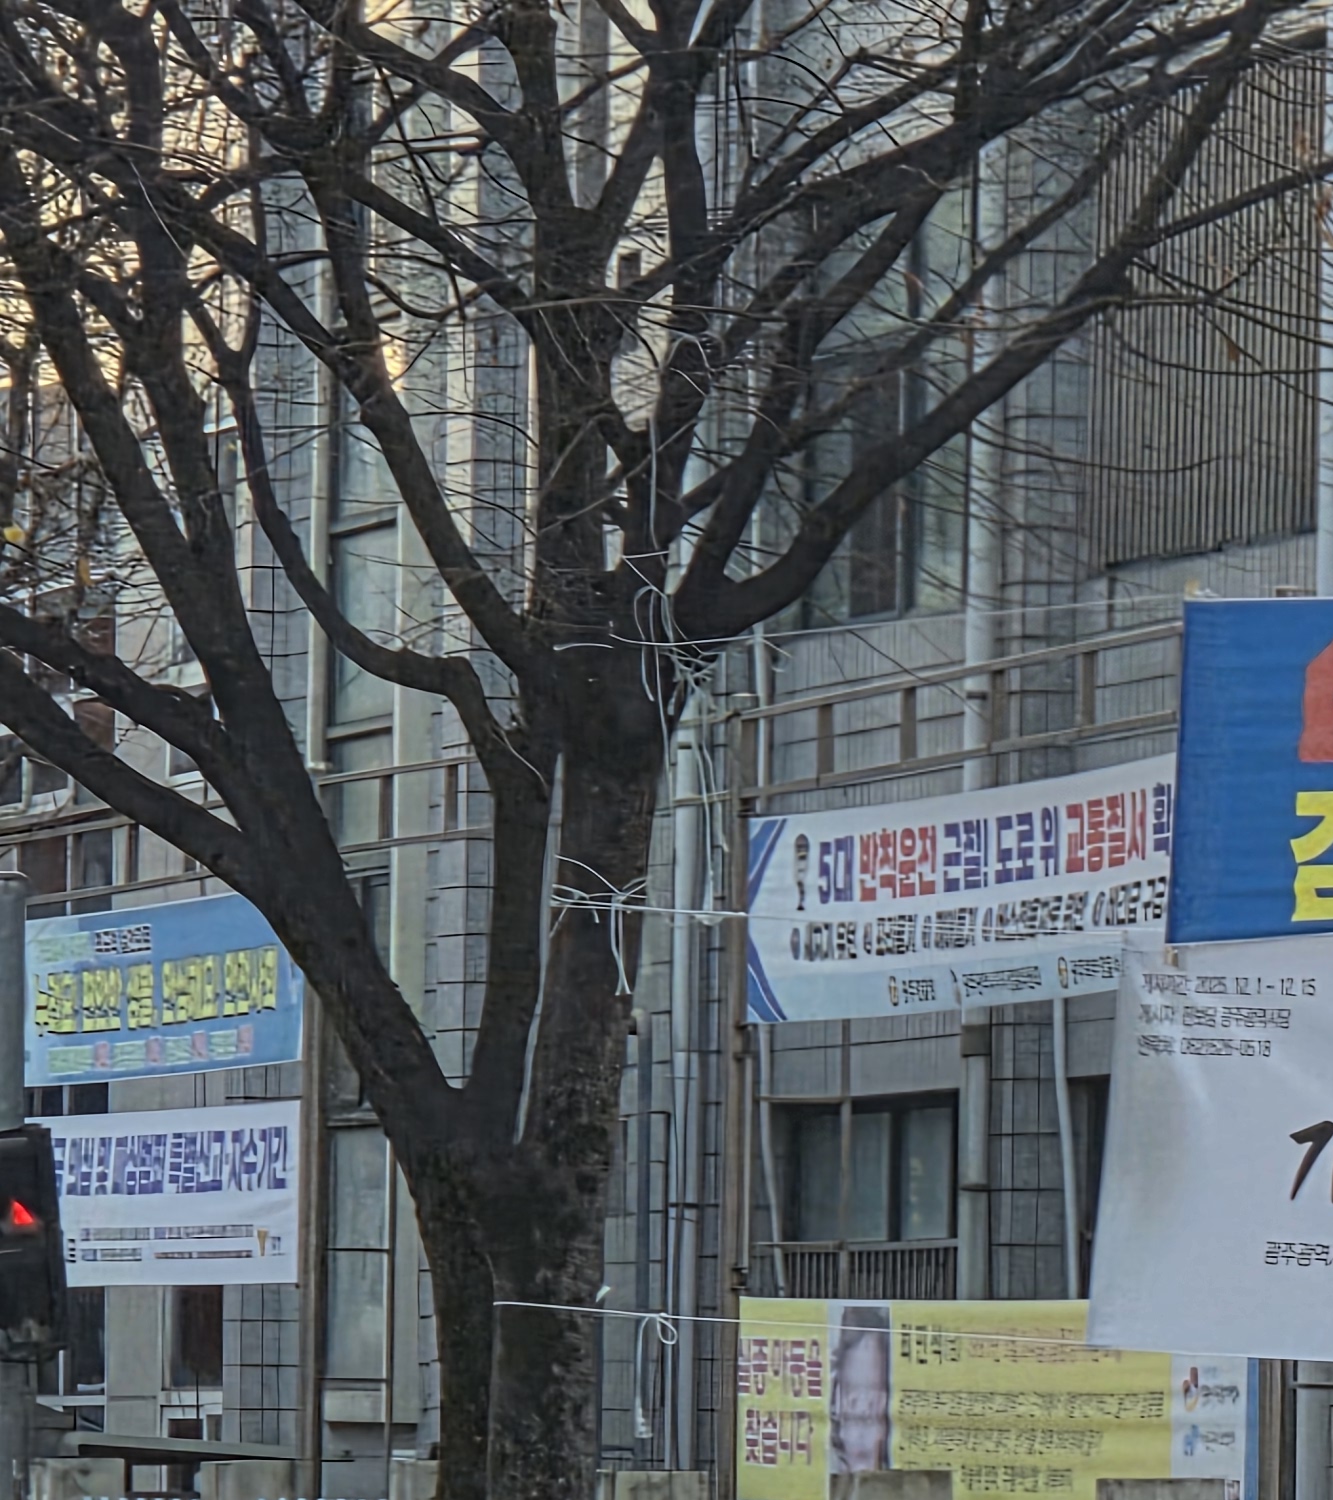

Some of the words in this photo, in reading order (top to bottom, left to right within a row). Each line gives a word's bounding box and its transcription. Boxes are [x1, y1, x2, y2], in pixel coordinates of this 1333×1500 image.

[818, 836, 854, 904] 5대
[859, 826, 936, 902] 반칙운전
[995, 812, 1034, 884] 도로
[1040, 806, 1059, 876] 위
[1066, 788, 1146, 874] 교통질서
